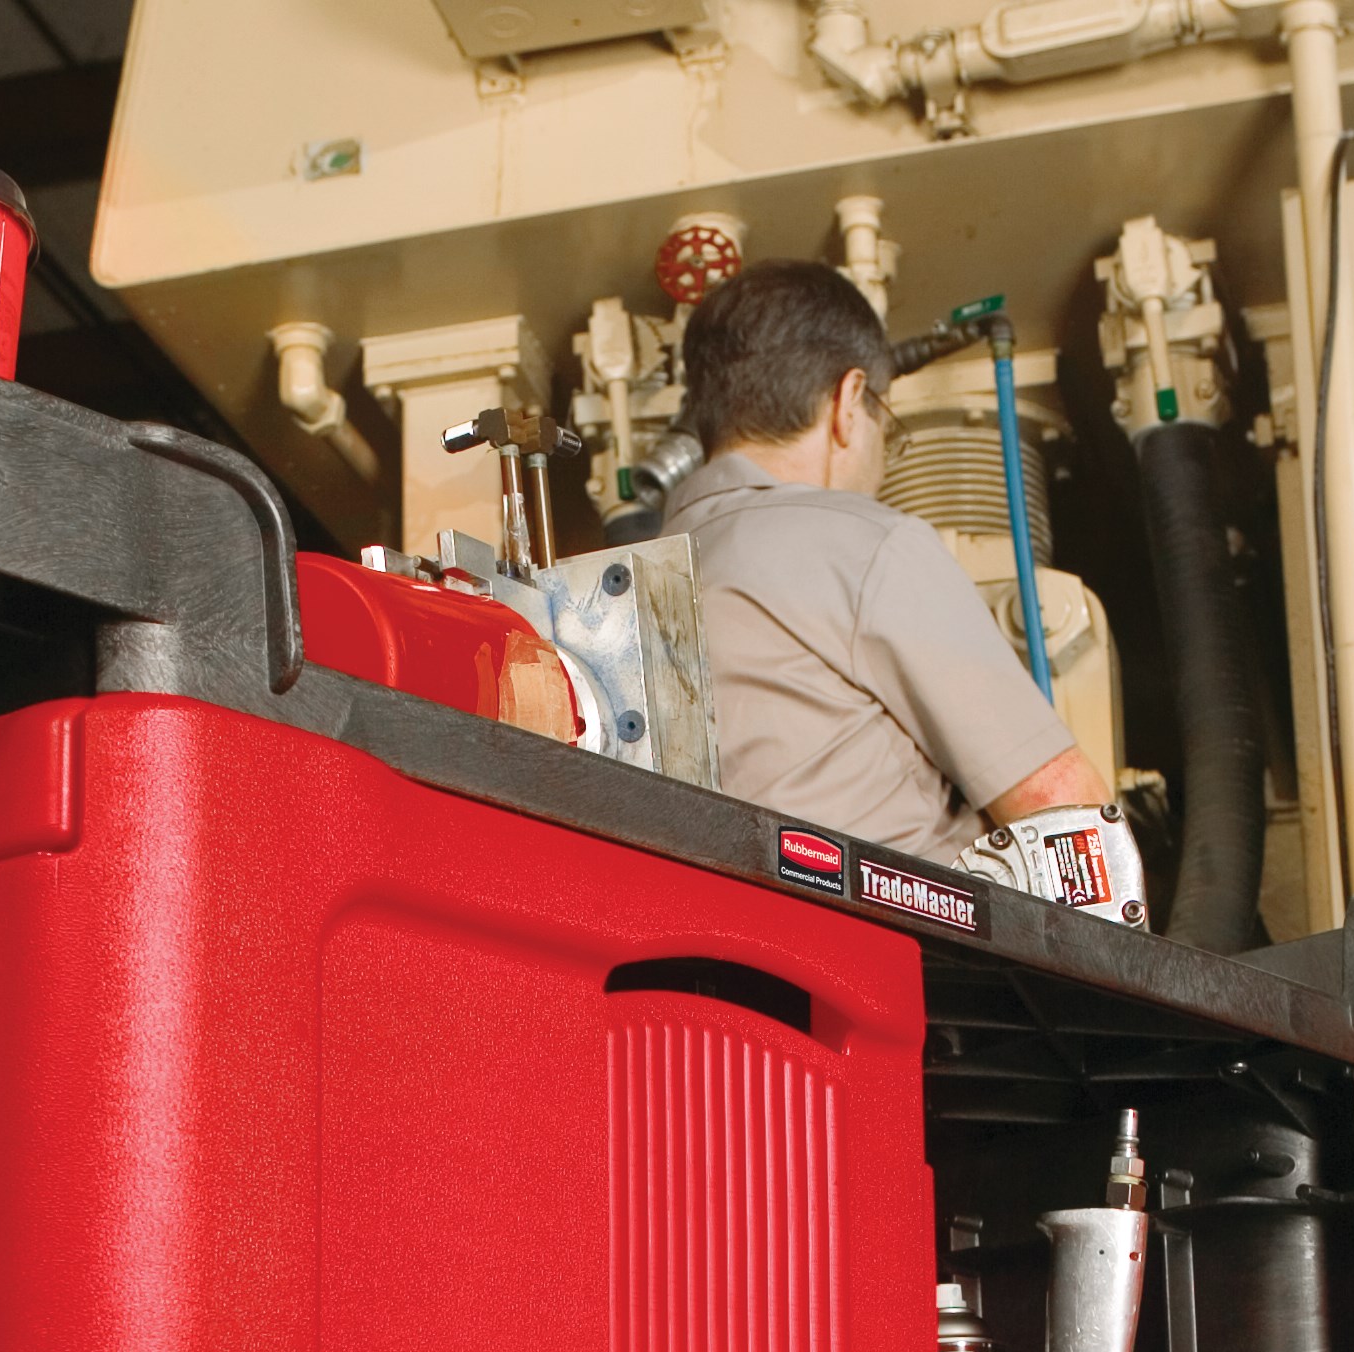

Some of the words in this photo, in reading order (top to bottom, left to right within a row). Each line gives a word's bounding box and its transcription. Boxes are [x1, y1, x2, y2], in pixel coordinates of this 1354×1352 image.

[783, 838, 839, 866] Rubbermaid
[780, 866, 815, 883] Commercial
[815, 876, 842, 891] Products
